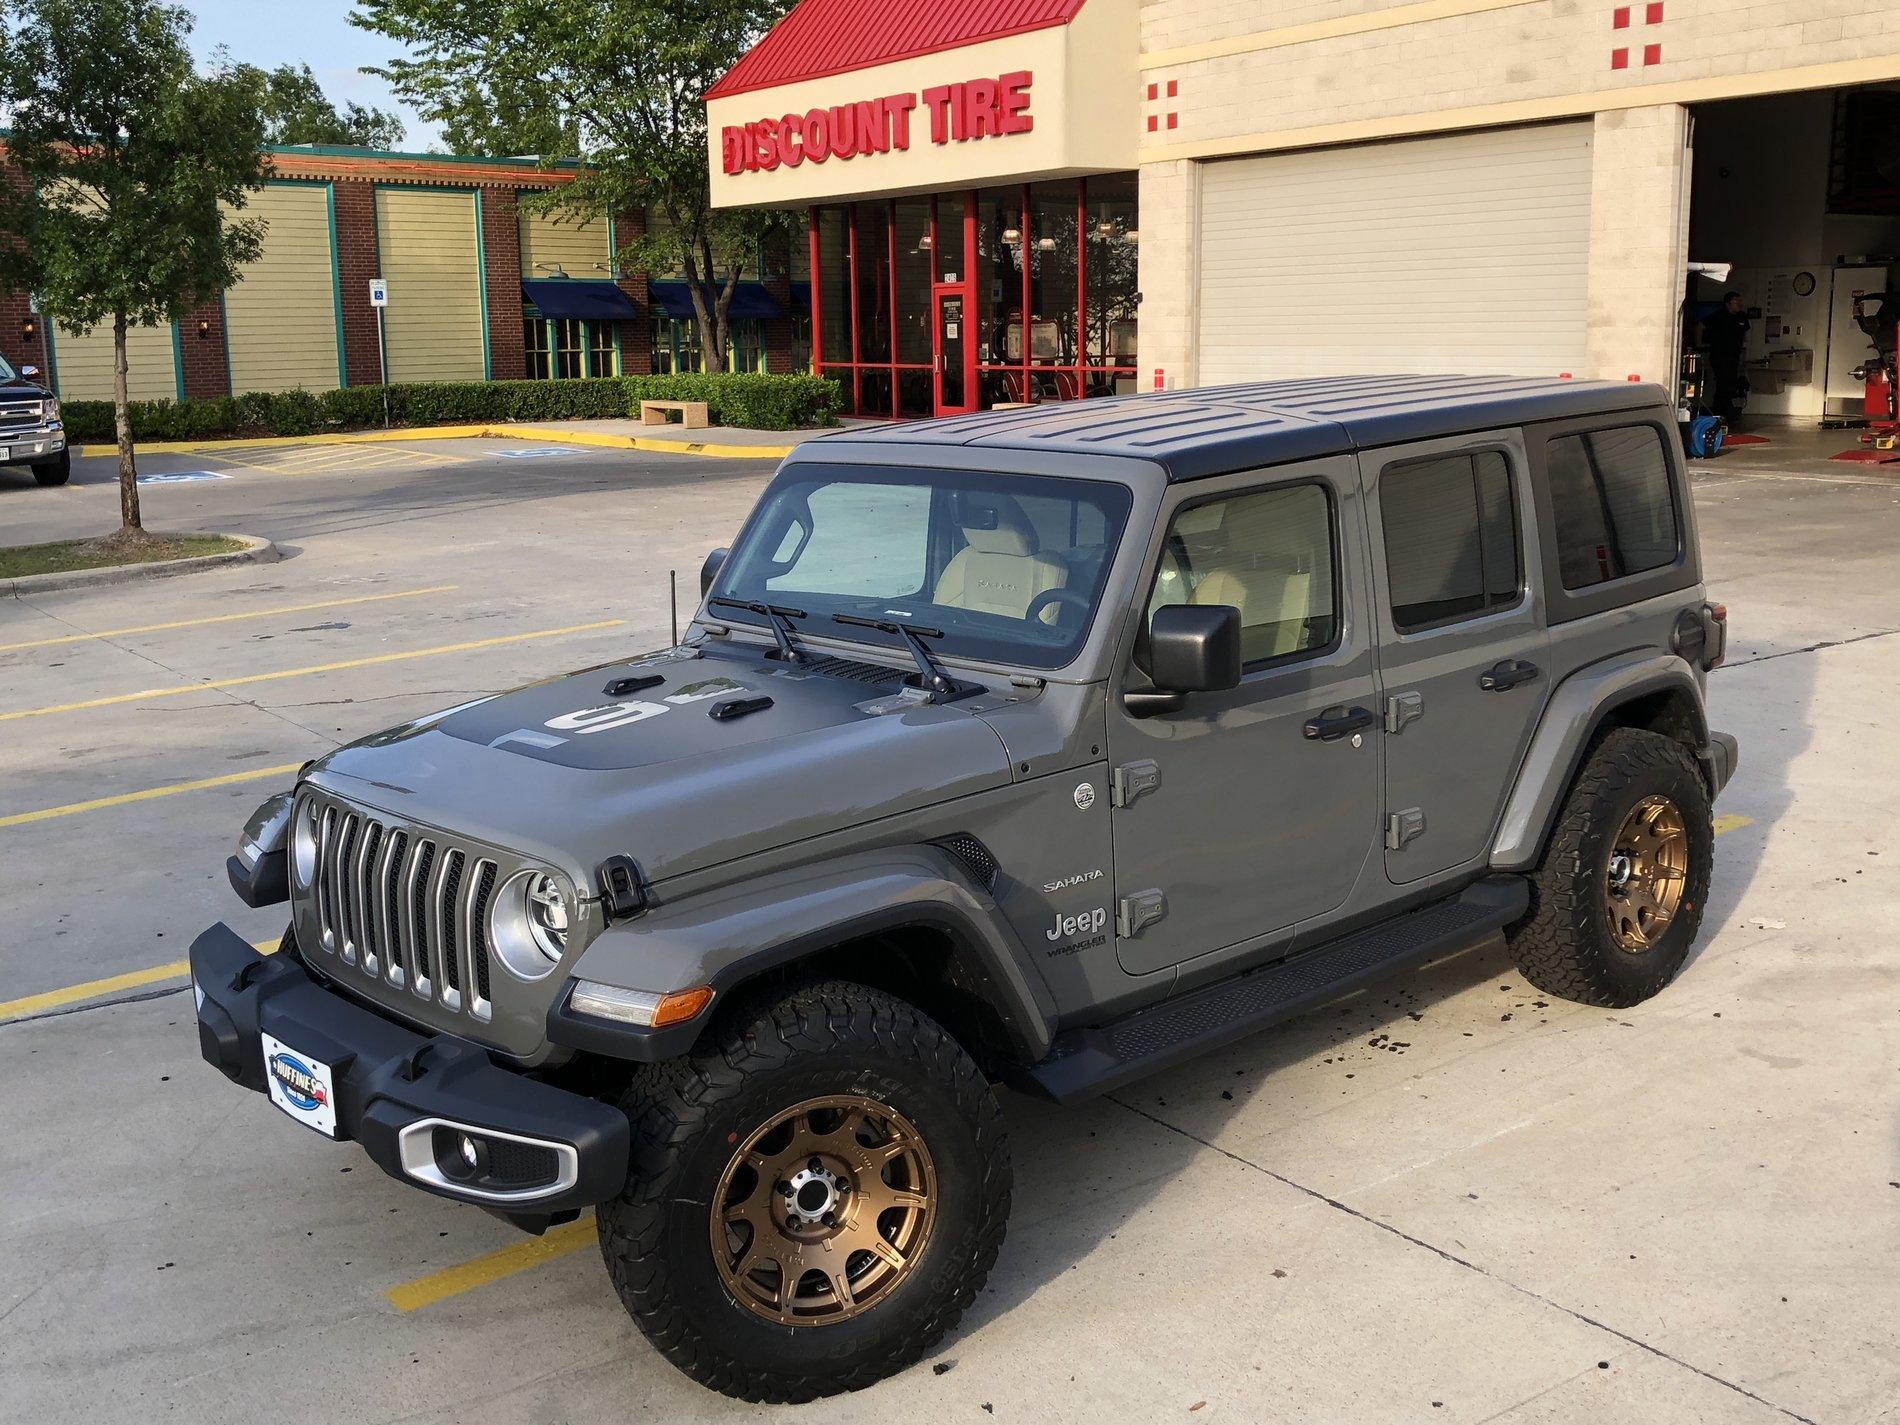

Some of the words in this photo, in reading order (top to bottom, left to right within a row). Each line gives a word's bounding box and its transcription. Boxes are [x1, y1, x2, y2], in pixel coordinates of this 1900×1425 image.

[722, 92, 917, 174] DISCOUNT
[922, 71, 1034, 144] TIRE
[1043, 869, 1104, 892] SAHARA
[1046, 907, 1107, 941] Jeep
[1047, 935, 1106, 958] WRANGLER
[276, 1060, 317, 1095] HUFFINES
